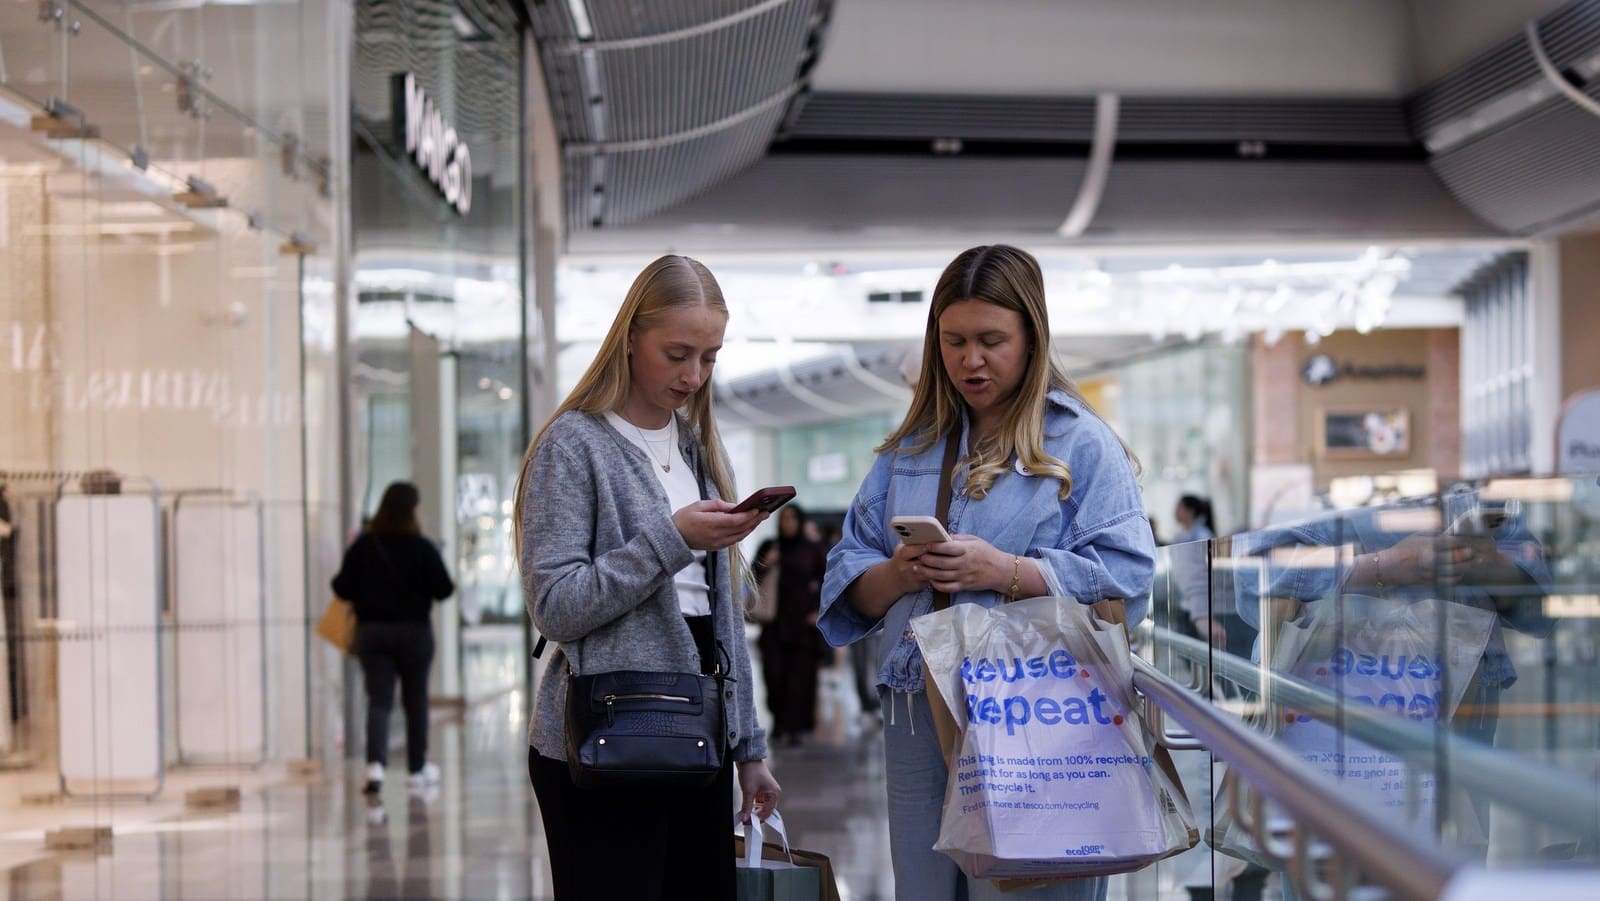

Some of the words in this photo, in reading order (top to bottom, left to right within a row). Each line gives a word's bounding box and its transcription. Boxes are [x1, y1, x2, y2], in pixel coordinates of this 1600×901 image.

[957, 755, 977, 768] This
[997, 755, 1005, 765] is
[1007, 756, 1035, 766] made
[1037, 756, 1062, 766] from
[1065, 755, 1093, 765] 100%
[1095, 754, 1140, 766] recycled
[958, 768, 988, 782] Reuse
[990, 767, 997, 778] it
[999, 767, 1014, 778] for
[1016, 771, 1027, 779] as
[1029, 770, 1051, 782] long
[1053, 771, 1064, 780] as
[1066, 771, 1086, 781] you
[1087, 770, 1111, 778] can.
[960, 783, 985, 796] Then
[988, 782, 1024, 793] recycle
[1025, 783, 1036, 793] it.
[993, 801, 1013, 810] more
[1023, 801, 1100, 811] tesco.com/recycling
